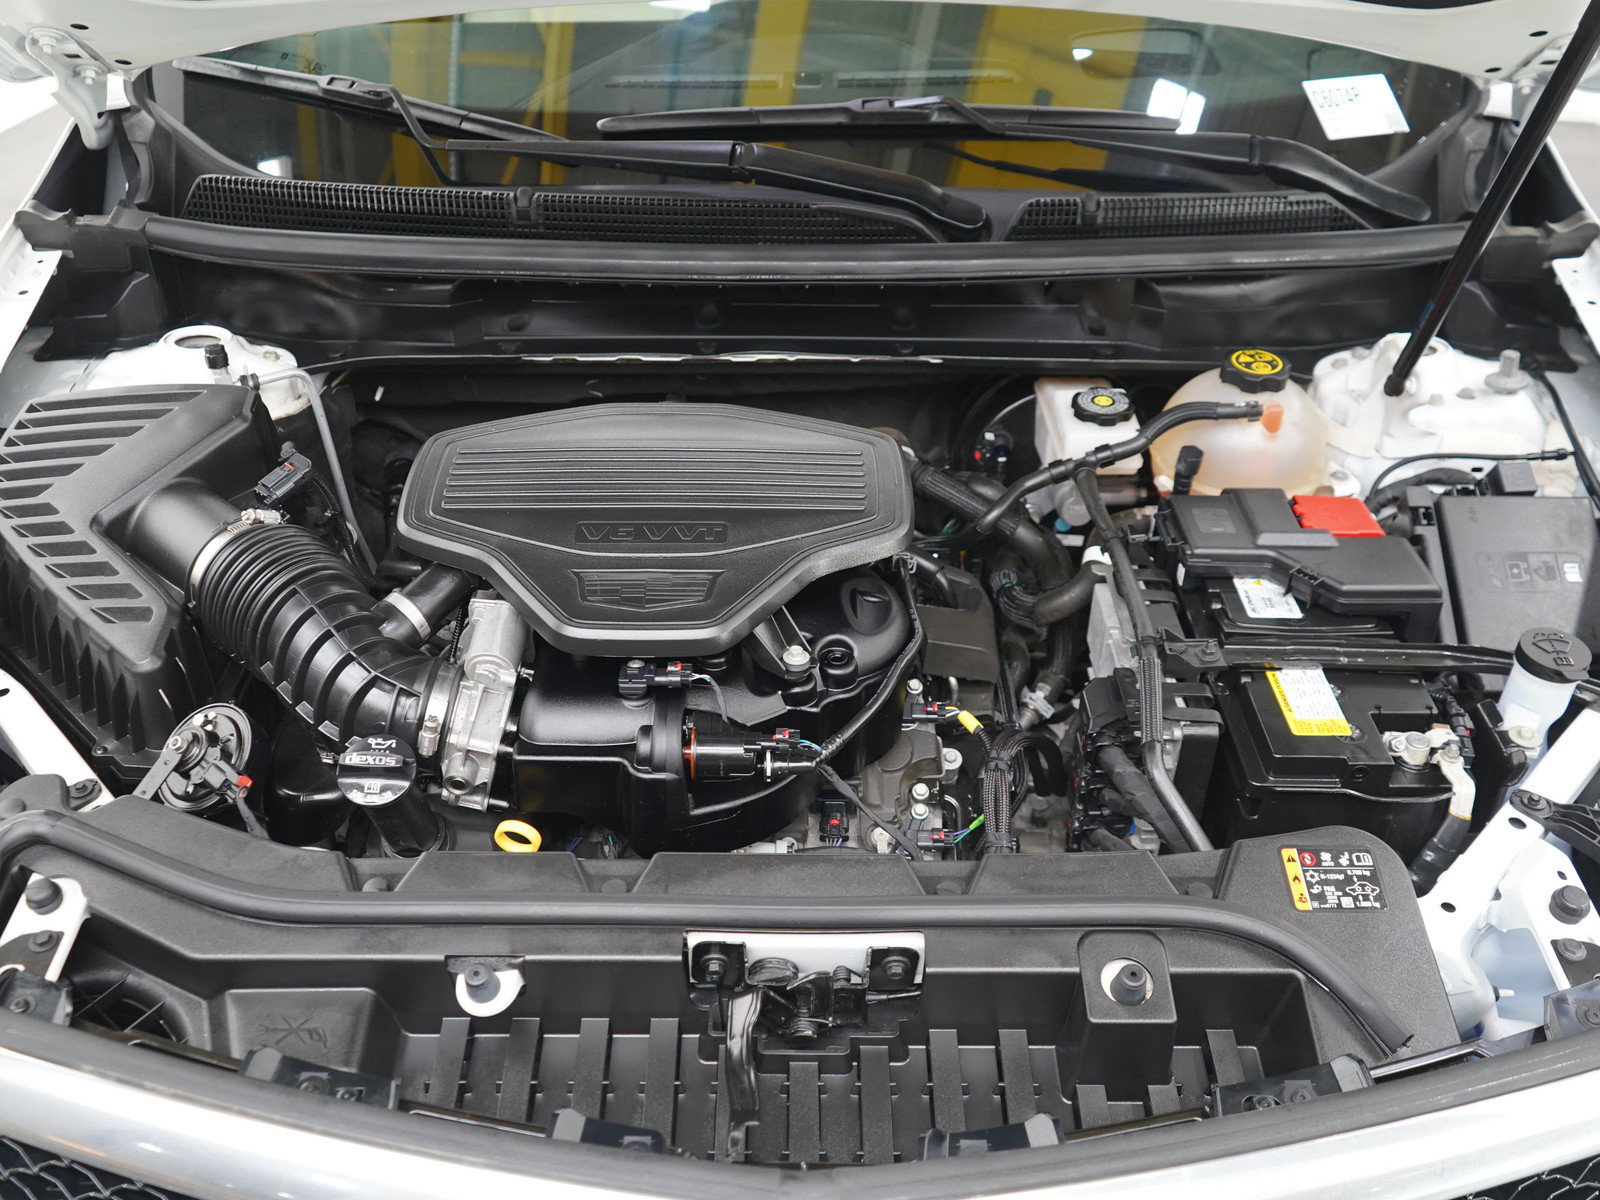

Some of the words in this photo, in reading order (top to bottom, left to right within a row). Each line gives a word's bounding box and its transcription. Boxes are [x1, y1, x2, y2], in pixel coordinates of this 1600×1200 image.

[581, 525, 635, 540] V6
[643, 525, 723, 540] VVT
[345, 752, 397, 766] dexos
